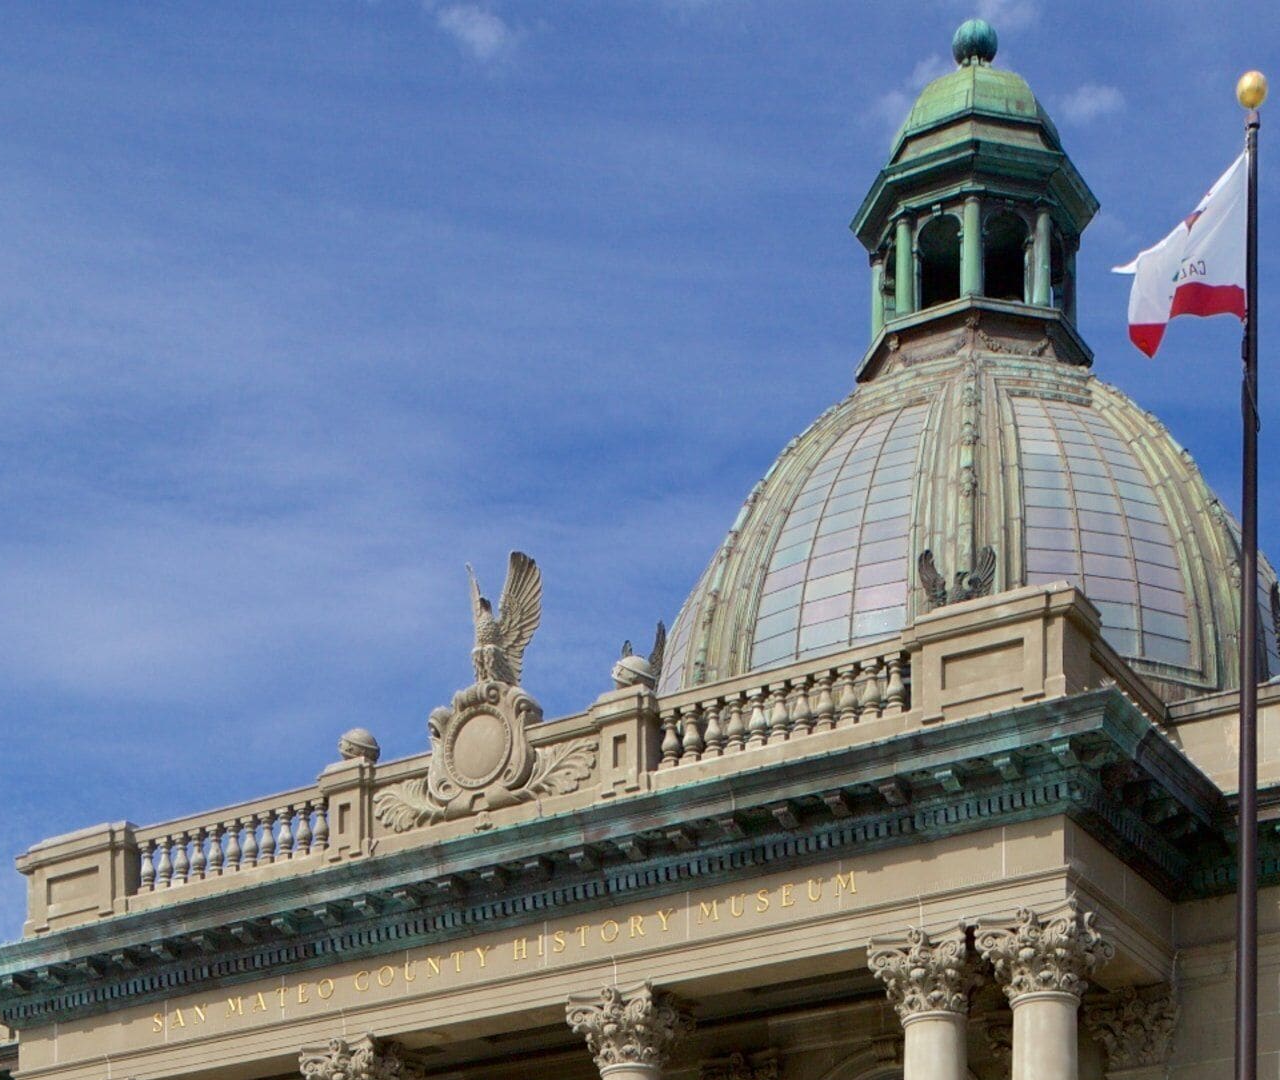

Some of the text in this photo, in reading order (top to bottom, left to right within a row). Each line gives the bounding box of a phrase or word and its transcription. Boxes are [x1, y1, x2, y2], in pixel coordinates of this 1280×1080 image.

[152, 870, 857, 1033] SAN MATEO COUNTY HISTORY MUSEUM
